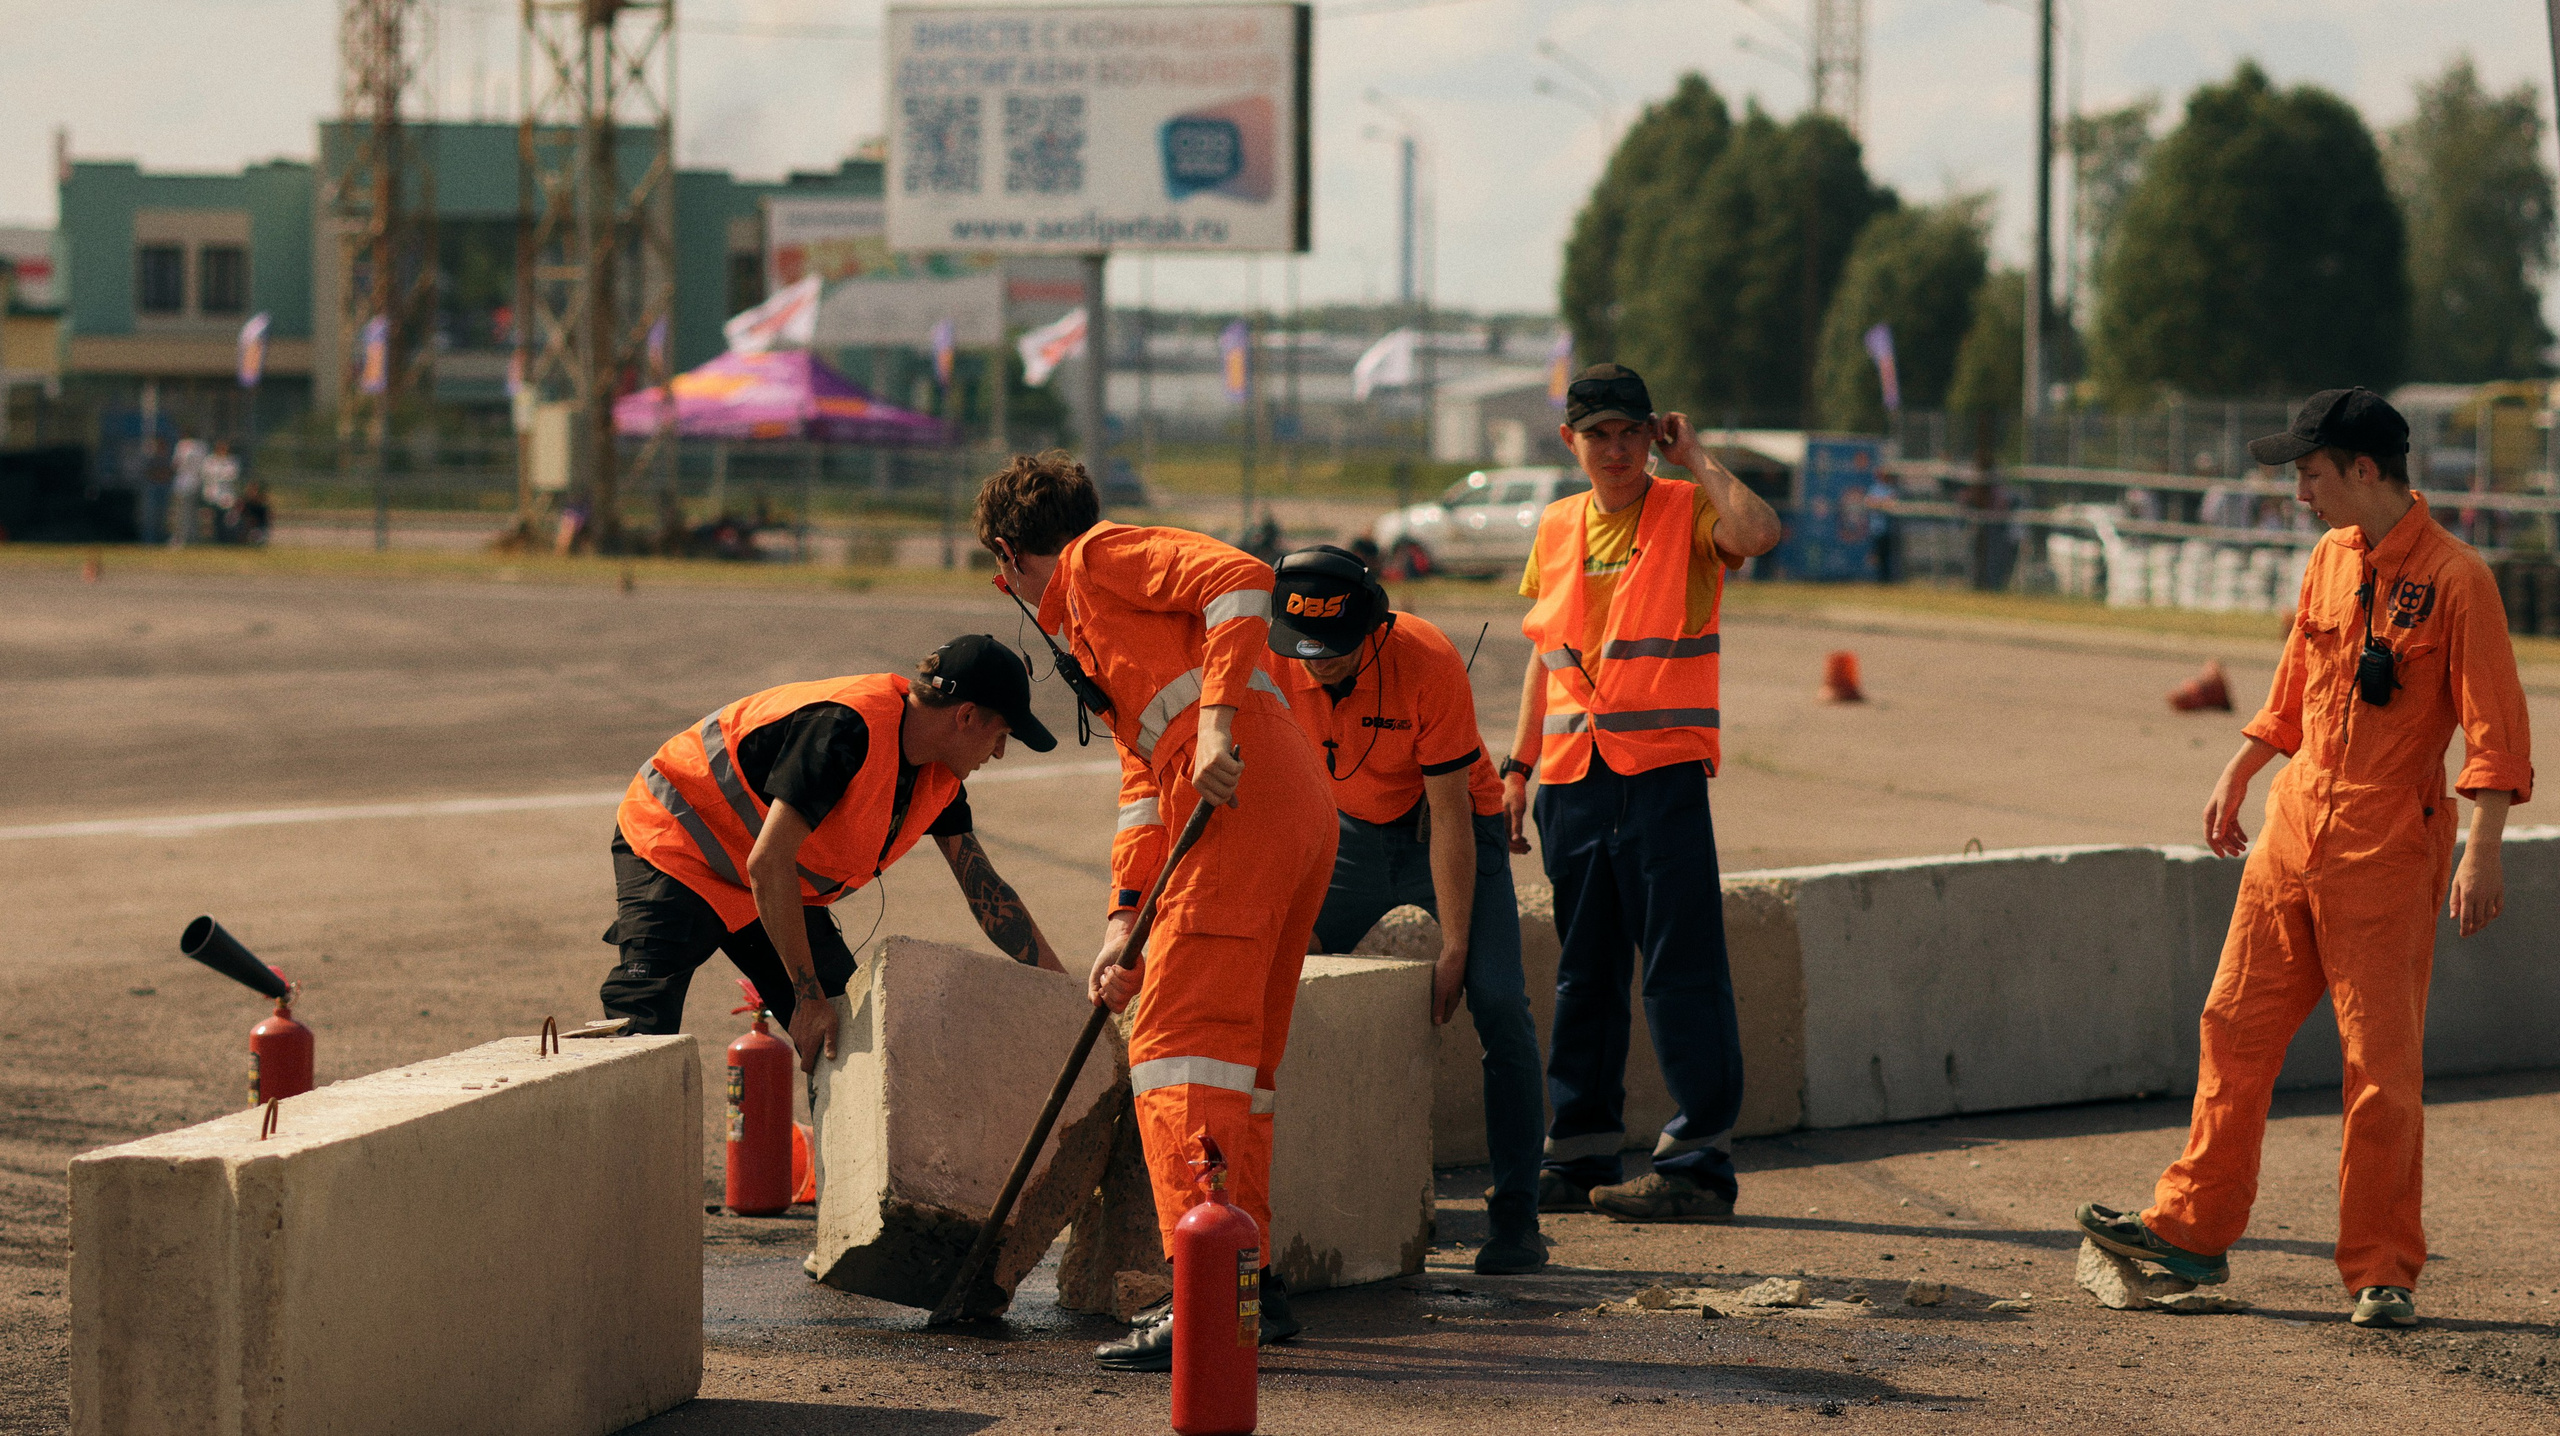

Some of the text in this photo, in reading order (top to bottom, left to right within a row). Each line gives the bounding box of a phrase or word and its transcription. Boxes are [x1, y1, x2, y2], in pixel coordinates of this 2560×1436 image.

[913, 20, 1032, 50] ВМЕСТЕ
[1041, 20, 1060, 50] С
[897, 56, 1087, 88] ДОСТИГАЕМ
[1286, 592, 1348, 618] DBS
[1362, 716, 1397, 730] DBS
